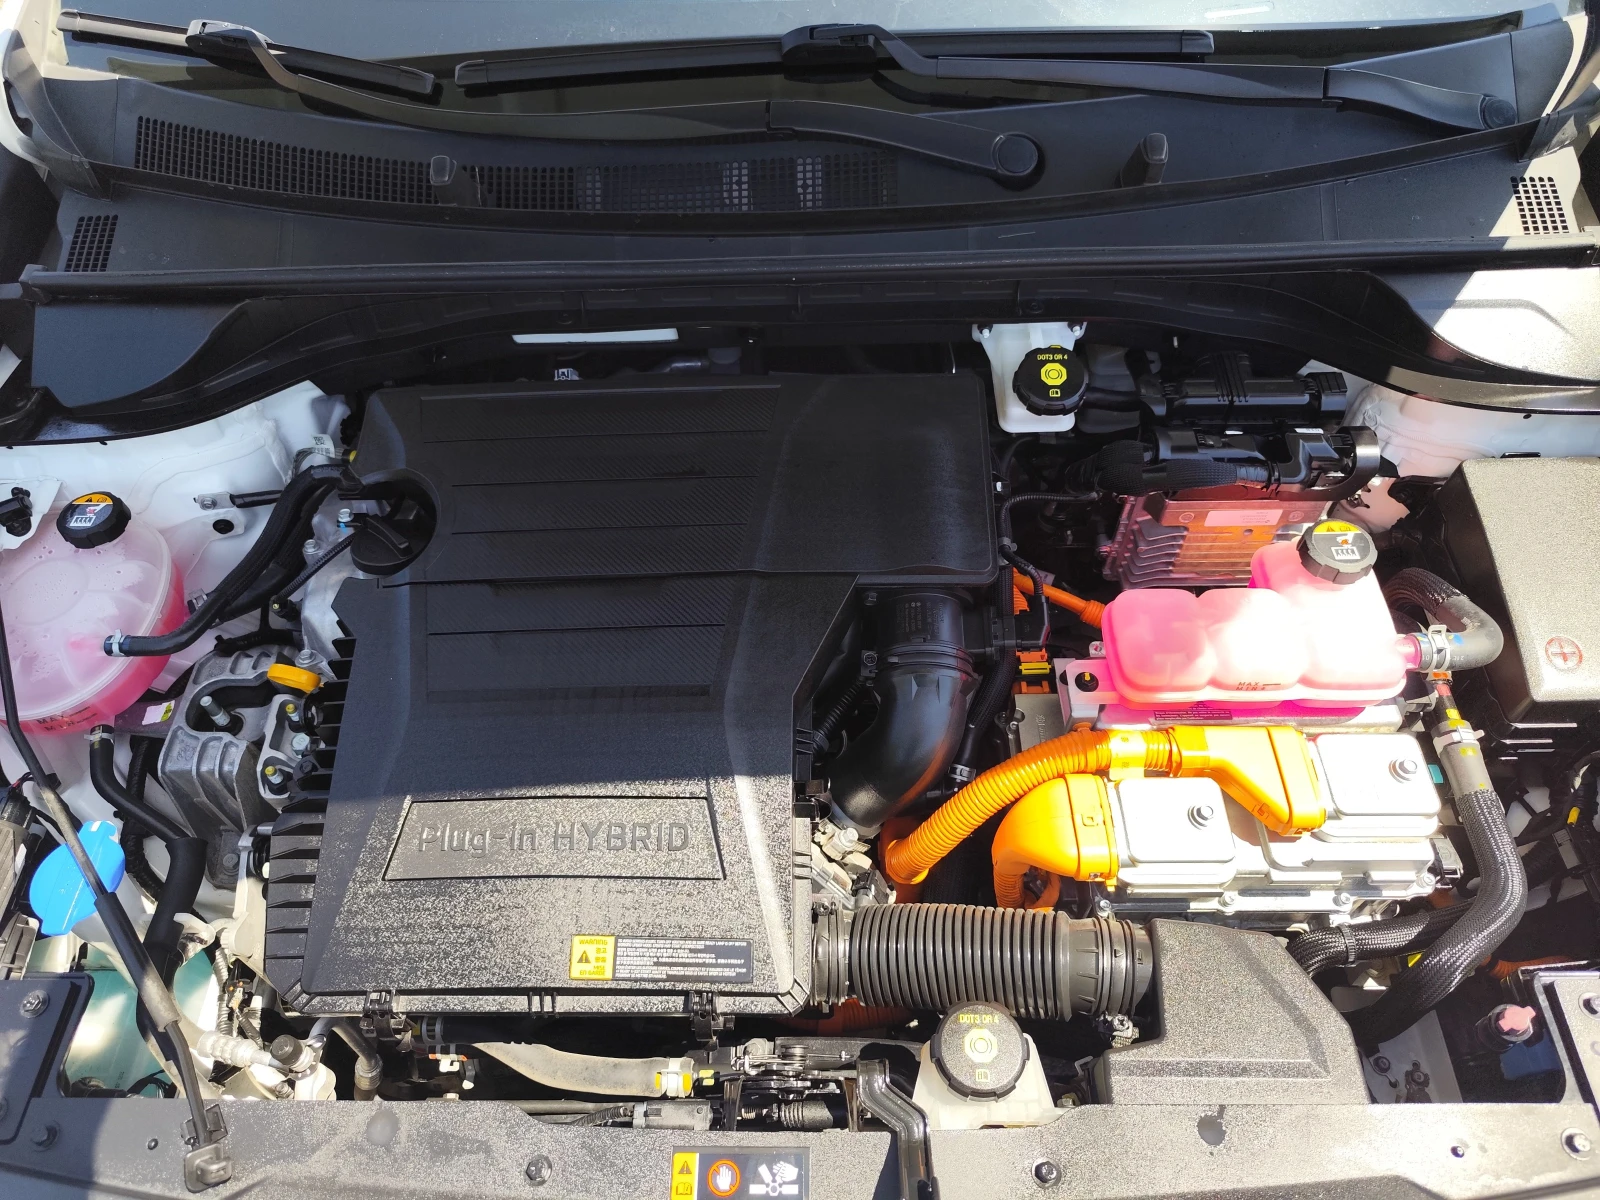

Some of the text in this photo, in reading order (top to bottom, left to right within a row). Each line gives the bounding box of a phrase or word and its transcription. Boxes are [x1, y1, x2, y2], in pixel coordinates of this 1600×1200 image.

[419, 822, 690, 858] Plug-in HYBRID
[959, 1014, 999, 1024] DOT3 OR 4
